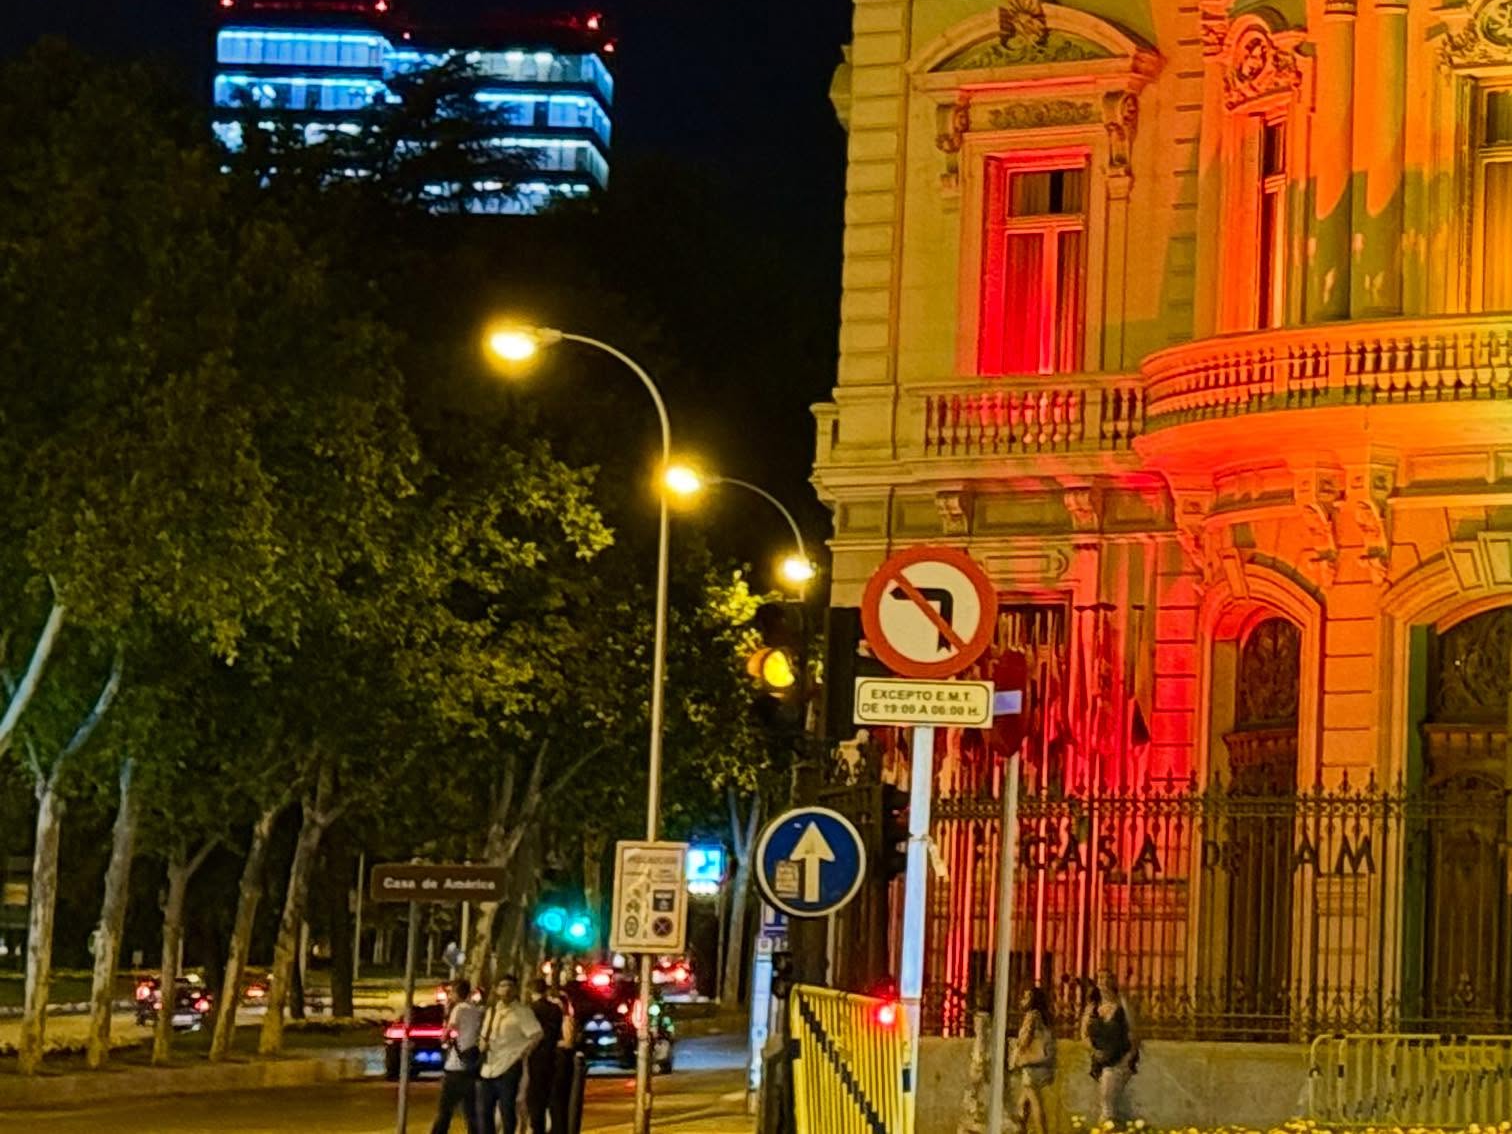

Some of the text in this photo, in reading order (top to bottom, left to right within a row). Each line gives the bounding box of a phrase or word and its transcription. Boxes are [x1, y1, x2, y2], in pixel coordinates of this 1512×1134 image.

[871, 689, 932, 701] EXCEPTO
[861, 703, 878, 714] DE
[918, 705, 928, 715] A
[1022, 833, 1162, 873] CASA
[383, 876, 415, 889] Casa
[421, 877, 438, 890] de
